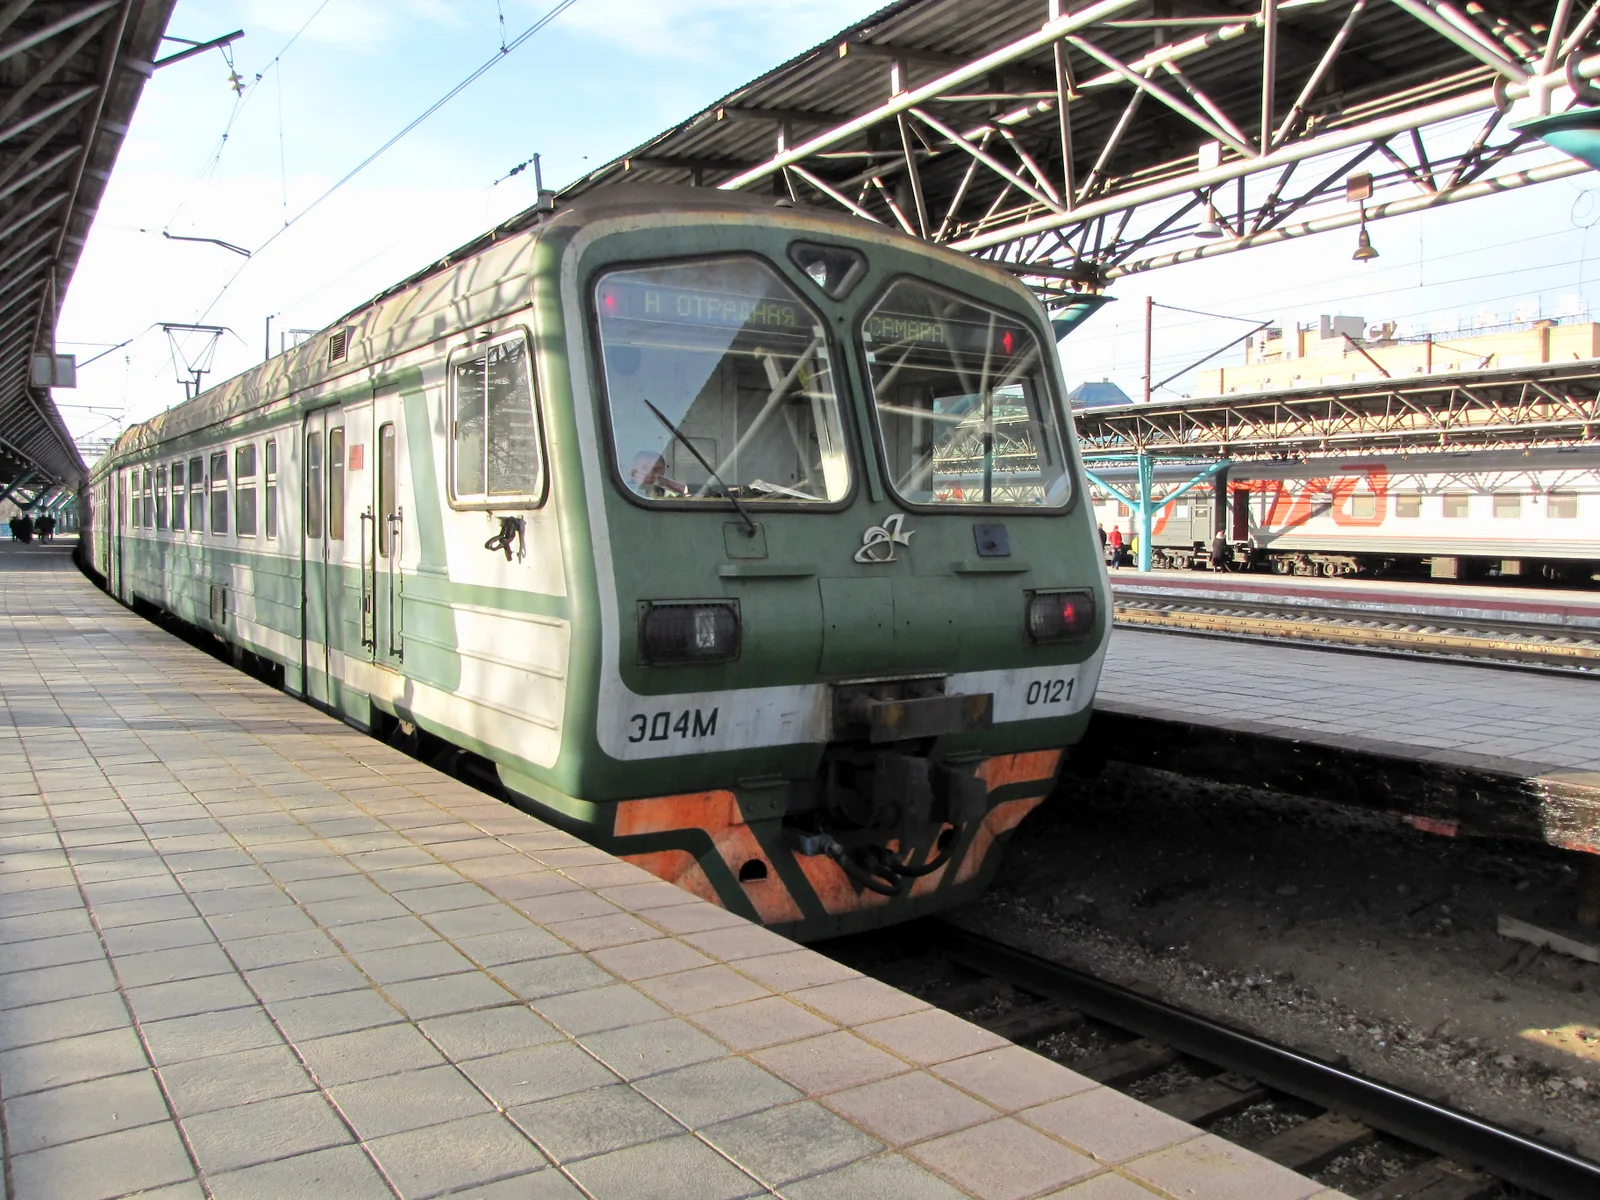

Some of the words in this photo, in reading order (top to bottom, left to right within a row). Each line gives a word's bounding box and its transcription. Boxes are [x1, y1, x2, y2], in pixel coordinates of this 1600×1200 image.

[644, 290, 660, 314] Н
[869, 316, 944, 343] САМАРА
[1026, 677, 1075, 706] 0121
[628, 707, 719, 743] ЭД4М
